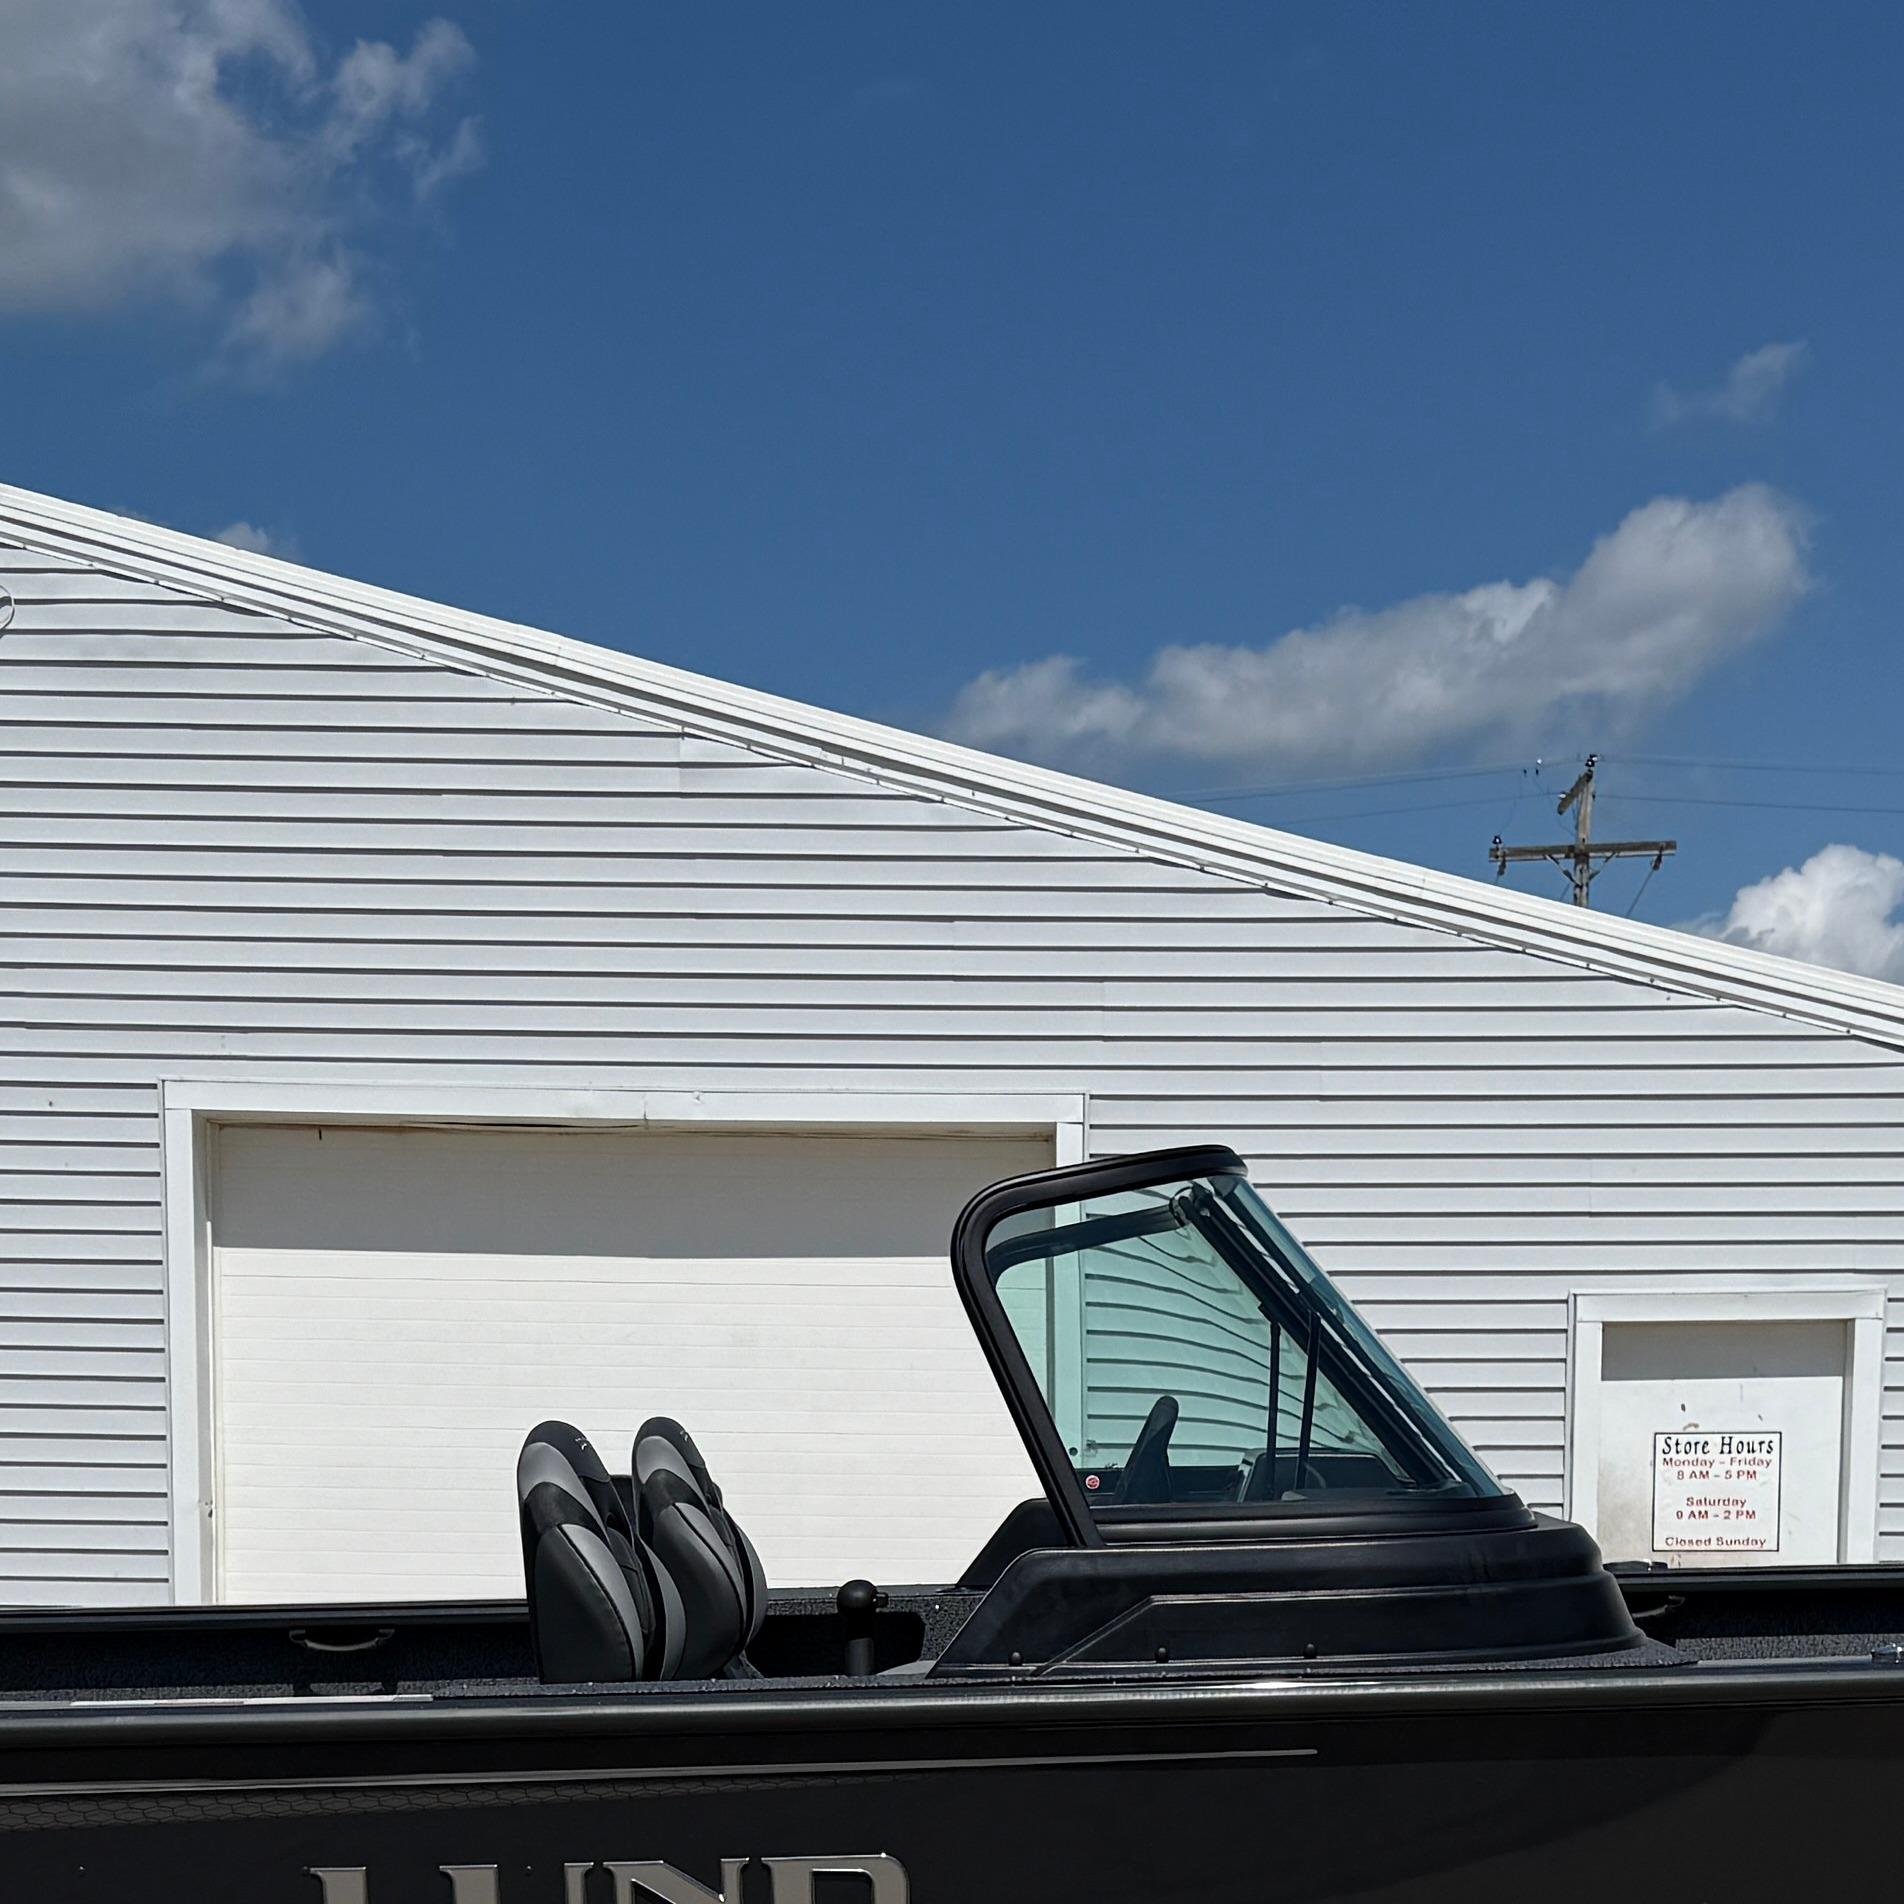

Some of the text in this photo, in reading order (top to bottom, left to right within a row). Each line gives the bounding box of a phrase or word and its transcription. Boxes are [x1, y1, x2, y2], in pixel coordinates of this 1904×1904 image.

[1662, 1436, 1774, 1455] Store Hours
[1662, 1457, 1715, 1468] Monday
[1730, 1457, 1772, 1468] Friday
[1689, 1470, 1710, 1480] AM
[1737, 1470, 1757, 1480] PM
[1686, 1497, 1747, 1508] Saturday
[1688, 1510, 1709, 1520] AM
[1723, 1510, 1731, 1520] 2
[1736, 1510, 1756, 1520] PM
[1665, 1537, 1767, 1548] Closed Sunday
